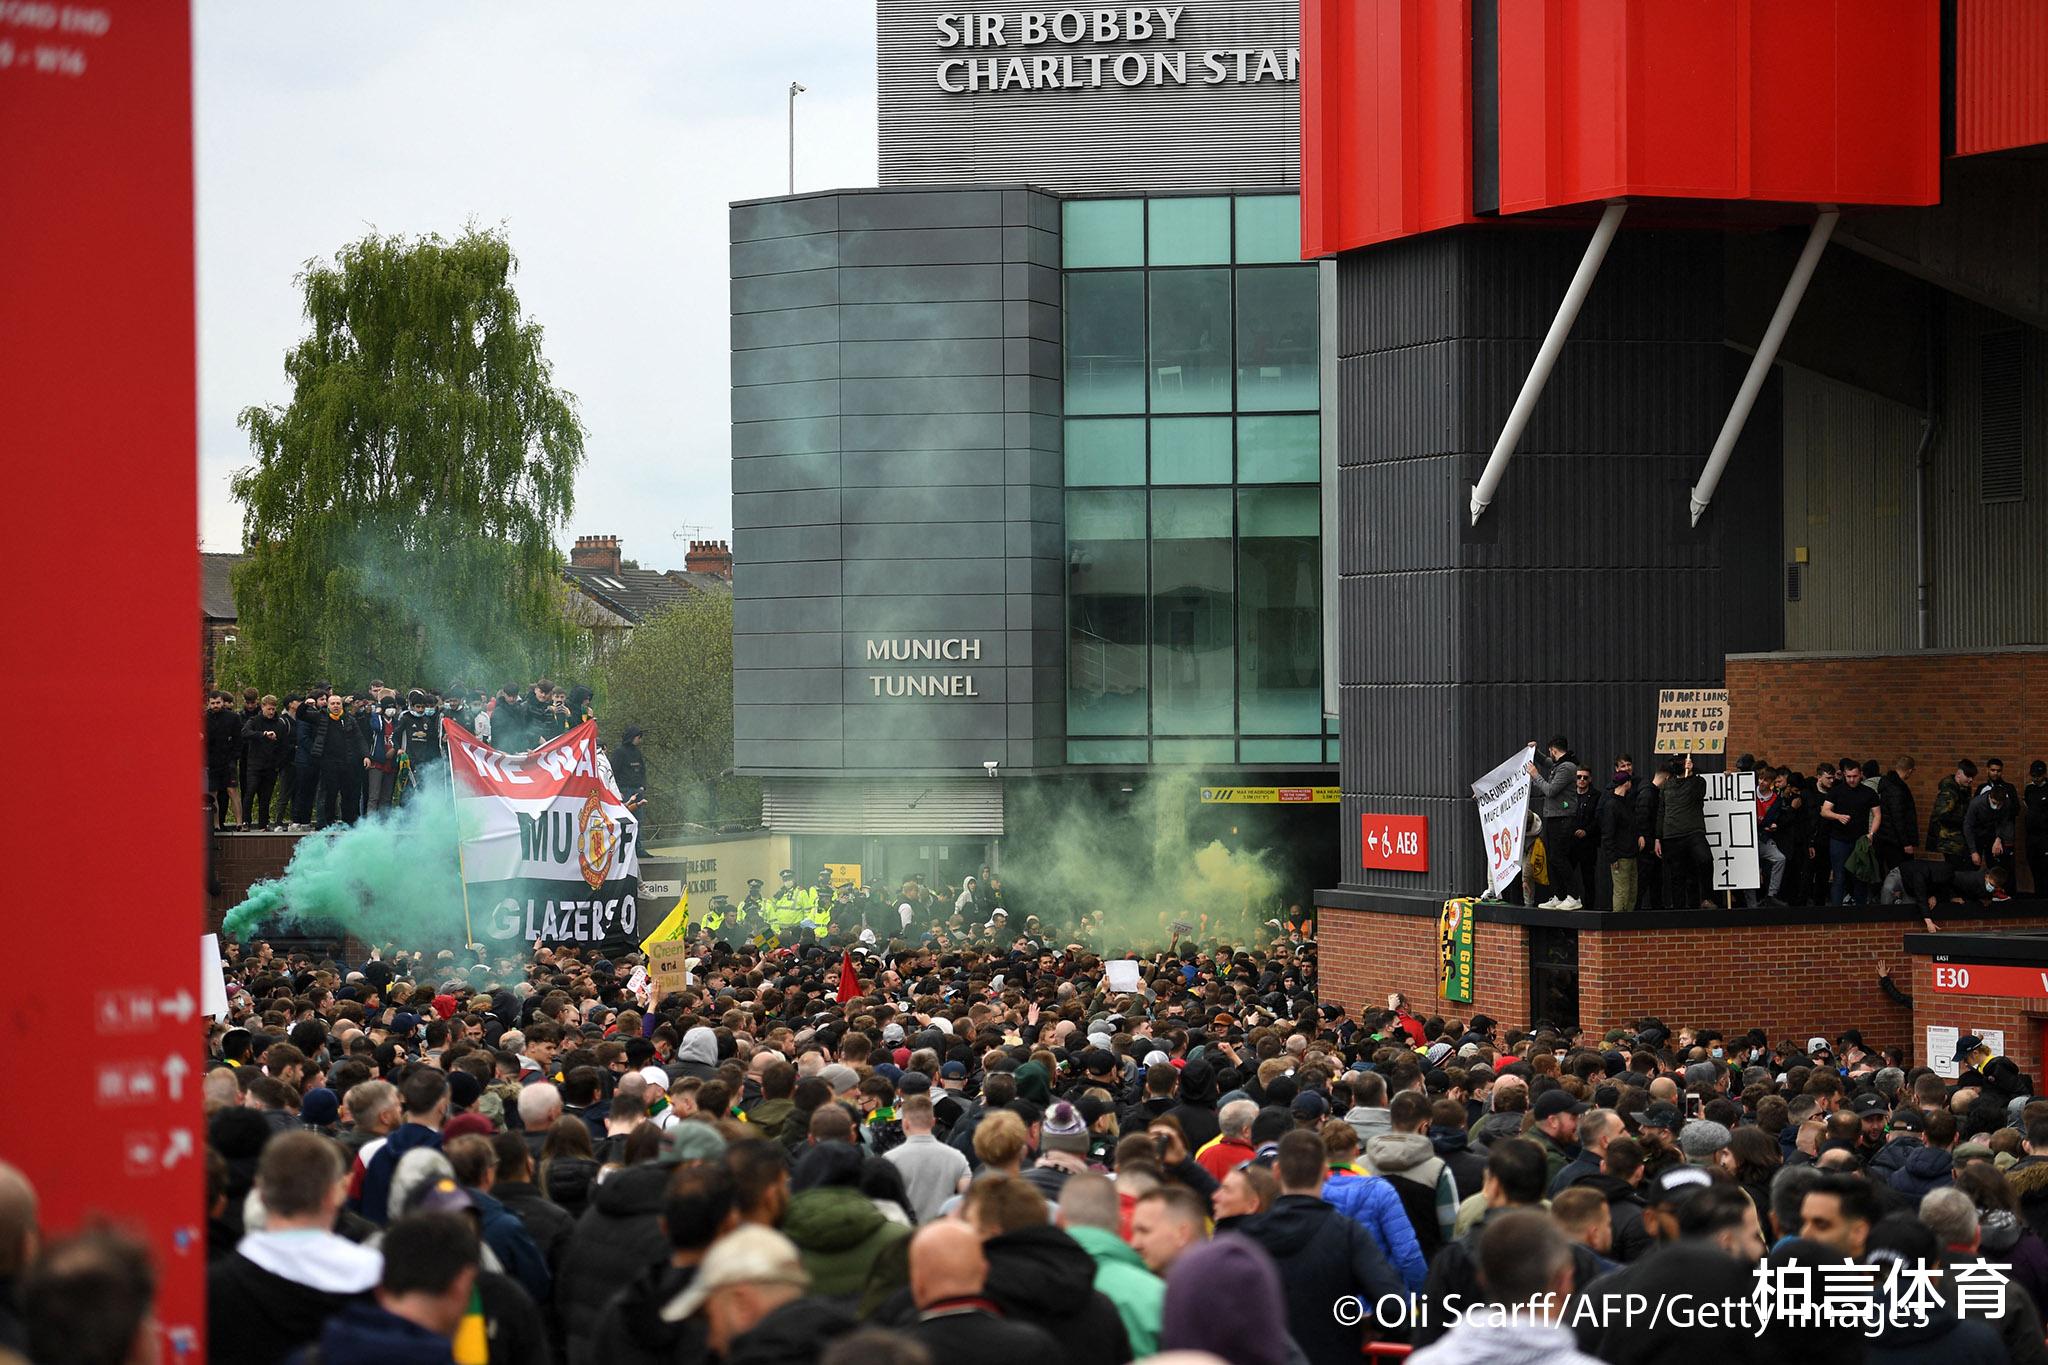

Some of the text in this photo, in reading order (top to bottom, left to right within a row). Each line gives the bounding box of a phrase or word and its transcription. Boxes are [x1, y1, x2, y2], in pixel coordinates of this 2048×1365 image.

[936, 6, 1186, 48] SIR BOBBY
[936, 51, 1187, 93] CHARLTON
[867, 639, 981, 660] MUNICH
[869, 675, 978, 697] TUNNEL
[1662, 691, 1728, 703] NO MORE LOANS
[1660, 707, 1723, 718] NO MORE LIES
[1659, 720, 1724, 733] TIME TO GO
[460, 738, 600, 784] WE WA
[1396, 831, 1418, 855] AE8
[661, 961, 677, 972] and
[1460, 950, 1471, 999] GONE
[1936, 967, 1970, 989] E30
